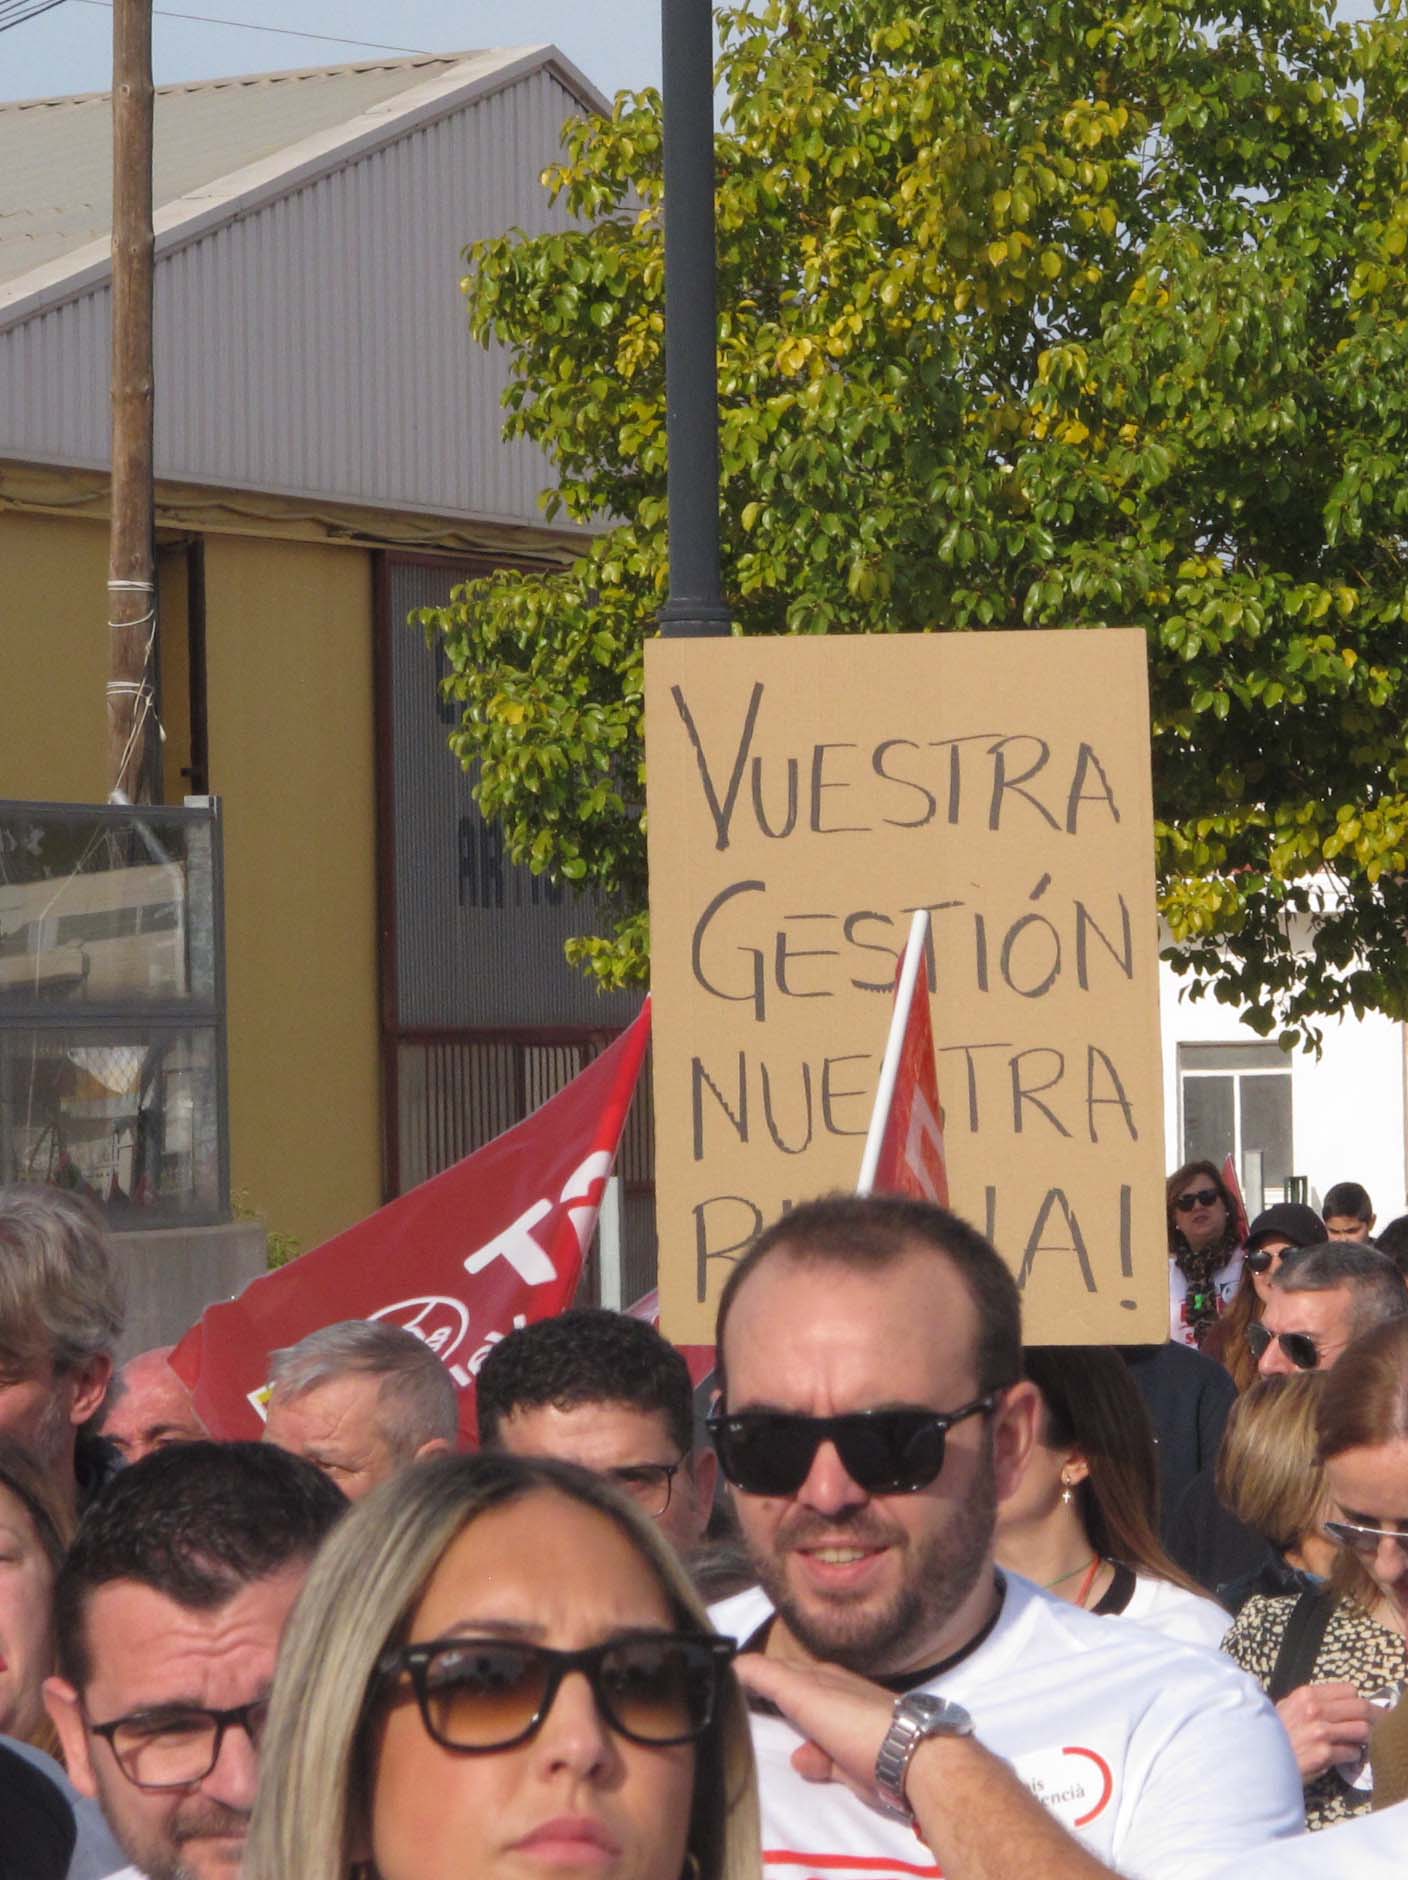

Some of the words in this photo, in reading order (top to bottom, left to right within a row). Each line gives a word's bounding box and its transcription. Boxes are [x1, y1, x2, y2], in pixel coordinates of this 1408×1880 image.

[671, 682, 1122, 851] VUESTRA
[691, 872, 1134, 1022] GESTIÓN
[692, 1042, 1139, 1160] NUETRA
[692, 1185, 1138, 1311] RA!
